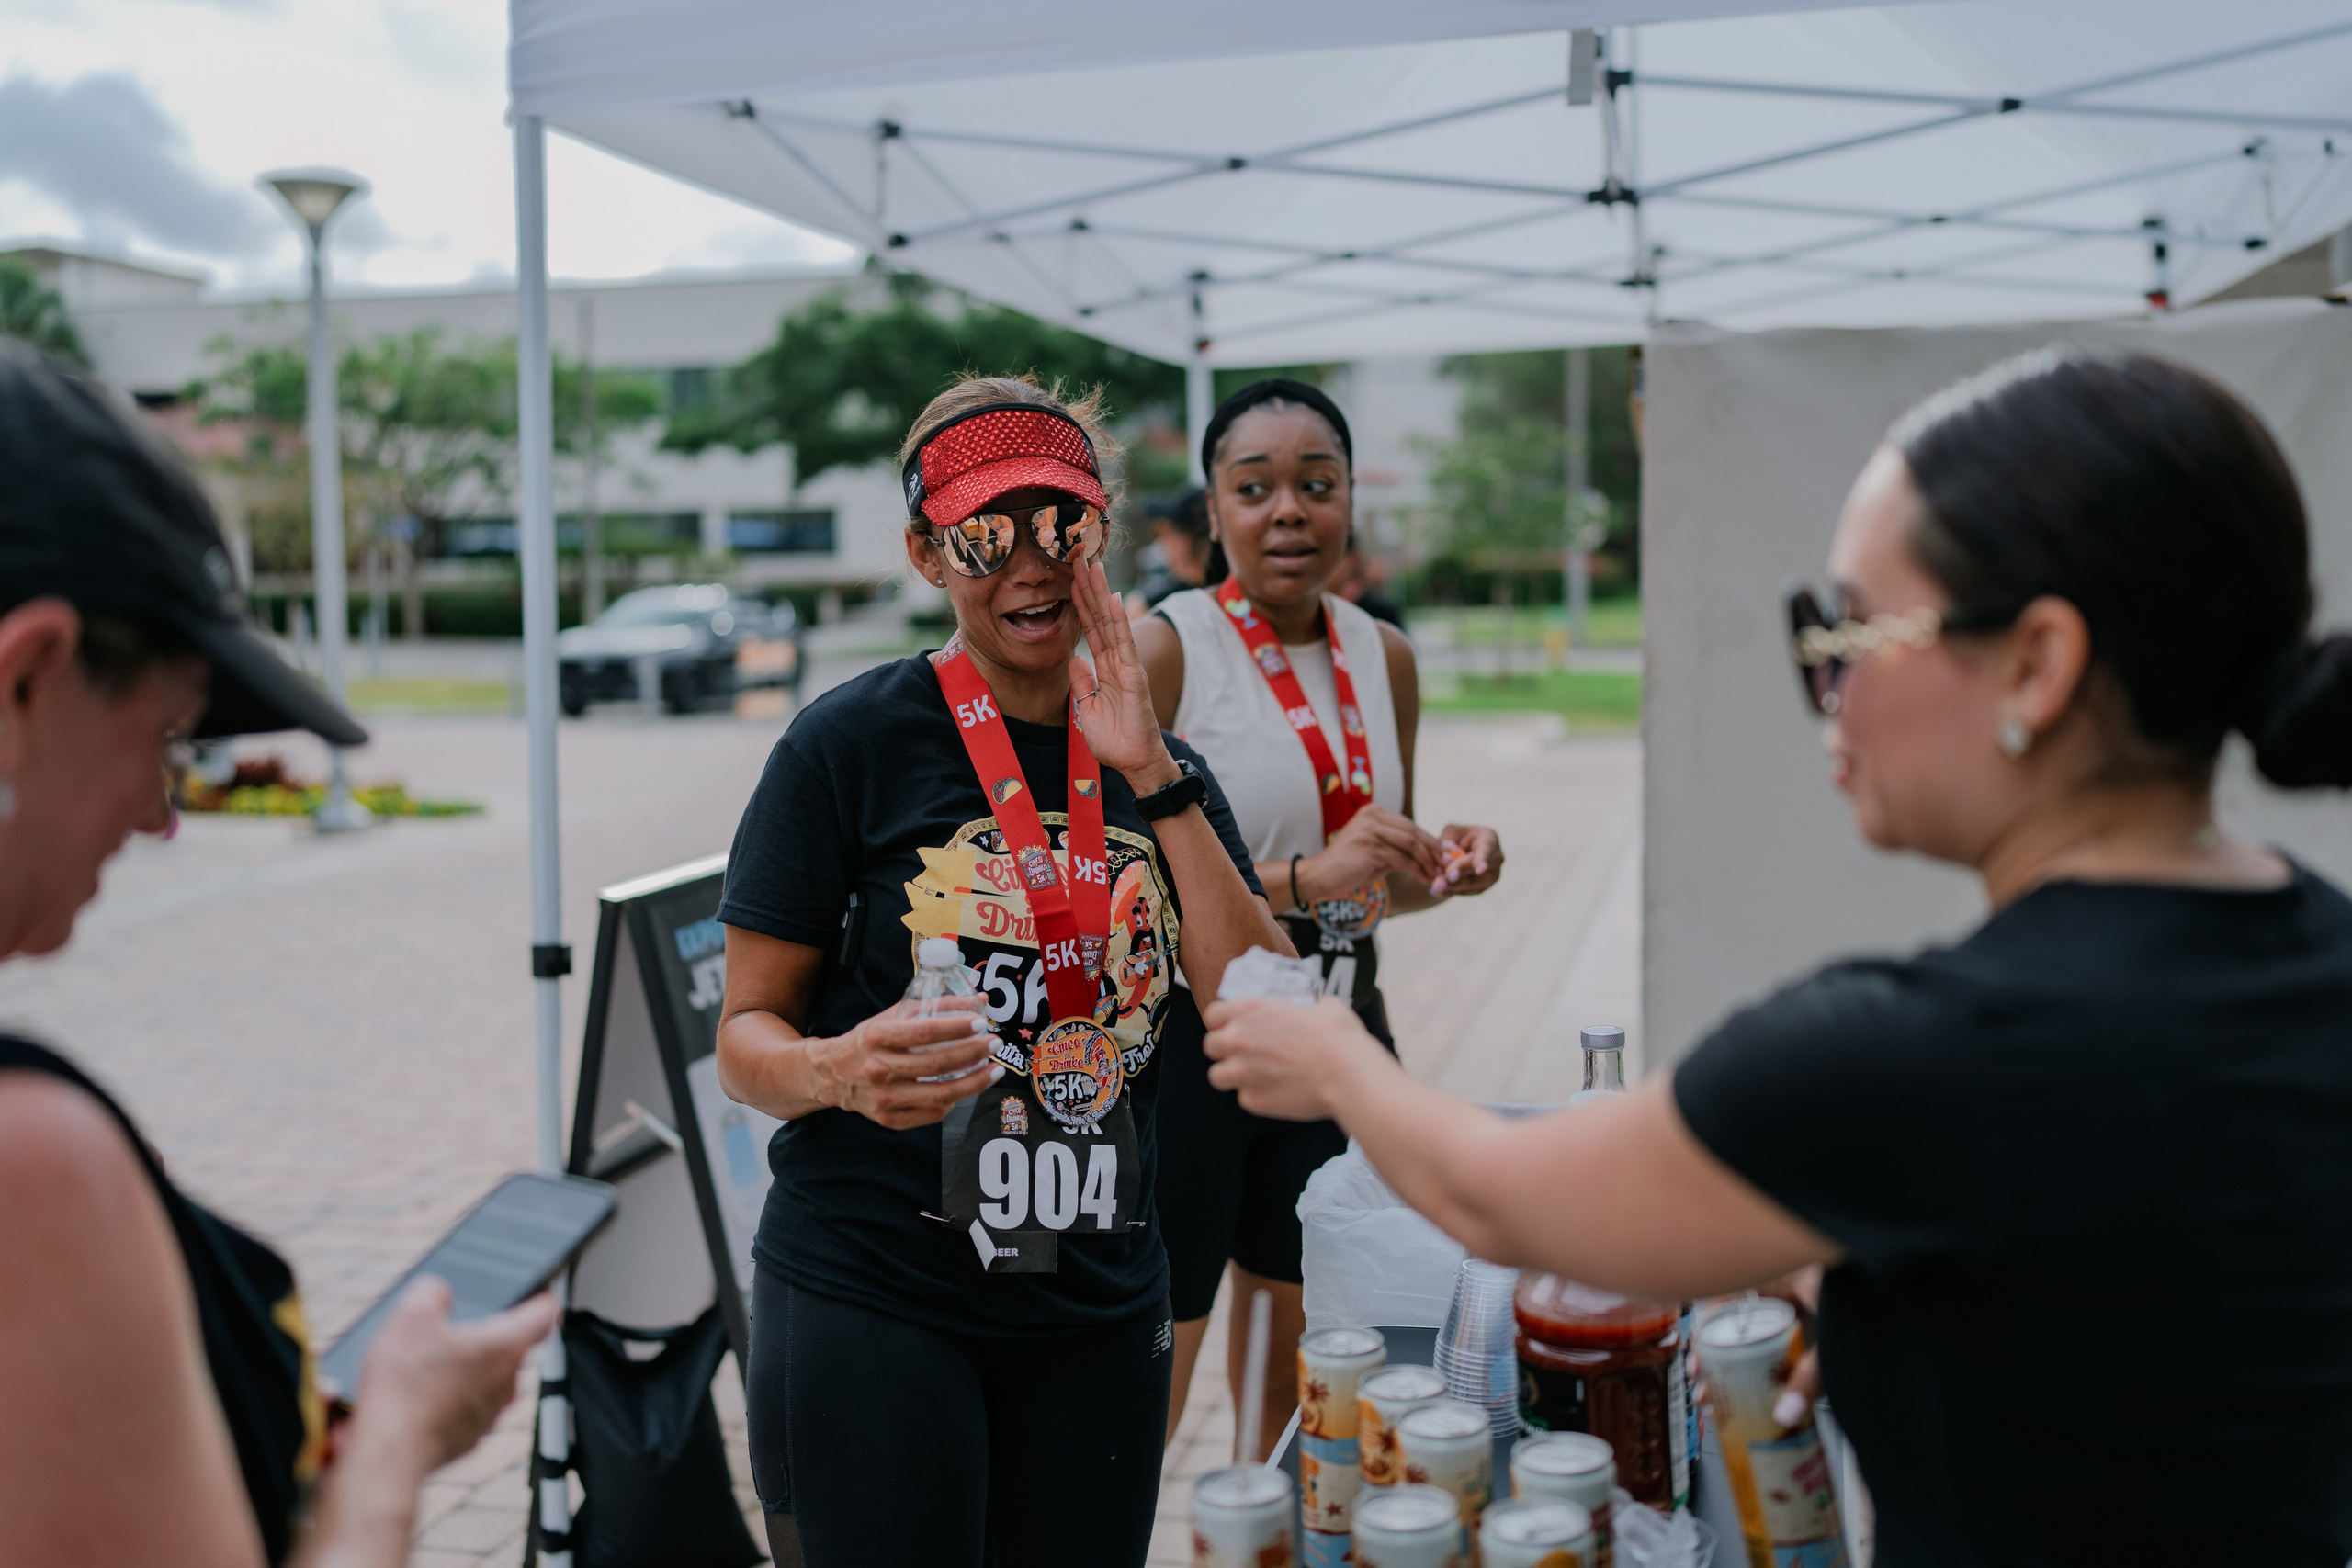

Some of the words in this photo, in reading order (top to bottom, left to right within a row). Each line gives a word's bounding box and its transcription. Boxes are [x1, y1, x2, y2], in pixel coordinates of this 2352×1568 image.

[956, 694, 997, 728] 5K
[1073, 855, 1106, 886] 5K
[1045, 938, 1080, 972] 5K
[1047, 1038, 1081, 1055] Cinco
[1120, 1032, 1155, 1072] Trot
[1048, 1055, 1085, 1072] Drinko
[1054, 1073, 1083, 1100] 5K
[978, 1137, 1118, 1231] 904
